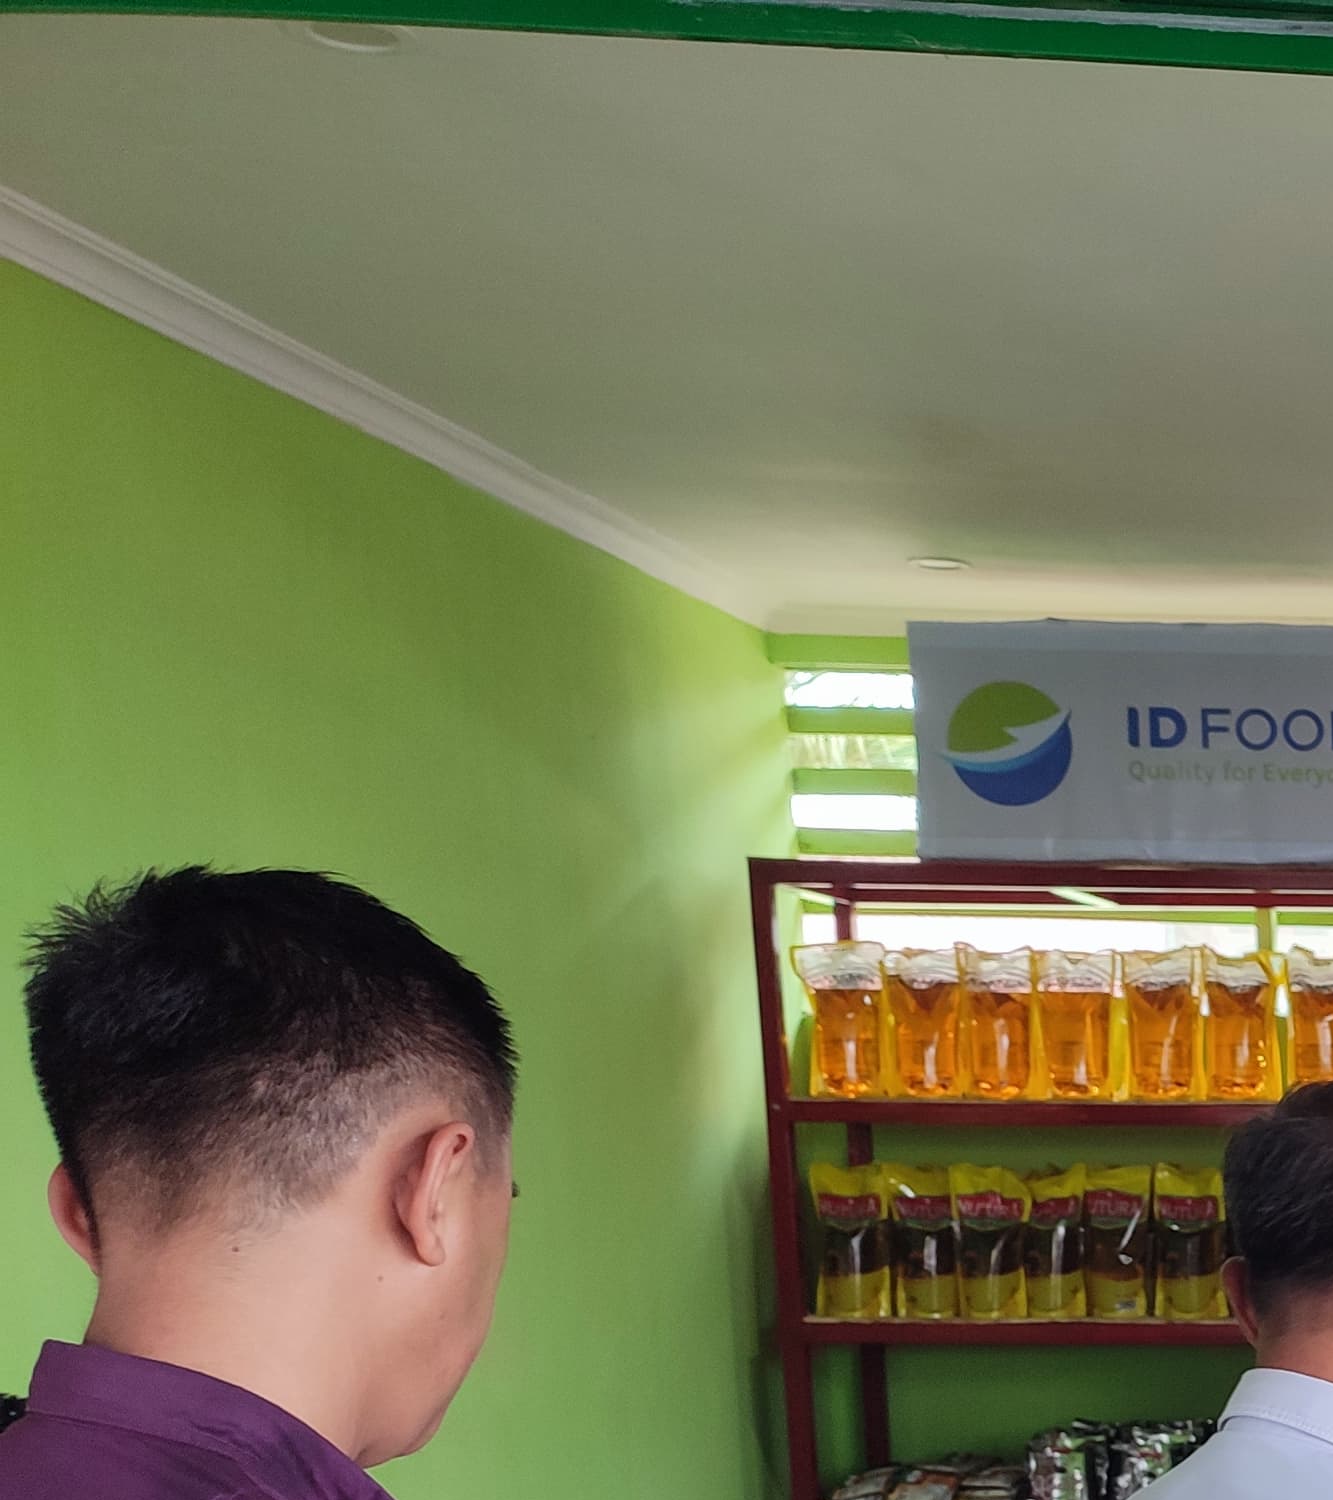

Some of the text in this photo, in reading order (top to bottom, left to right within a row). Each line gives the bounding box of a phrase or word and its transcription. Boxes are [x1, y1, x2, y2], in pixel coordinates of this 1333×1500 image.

[1126, 706, 1188, 749] ID
[1128, 759, 1215, 784] Quality
[1223, 759, 1255, 782] for
